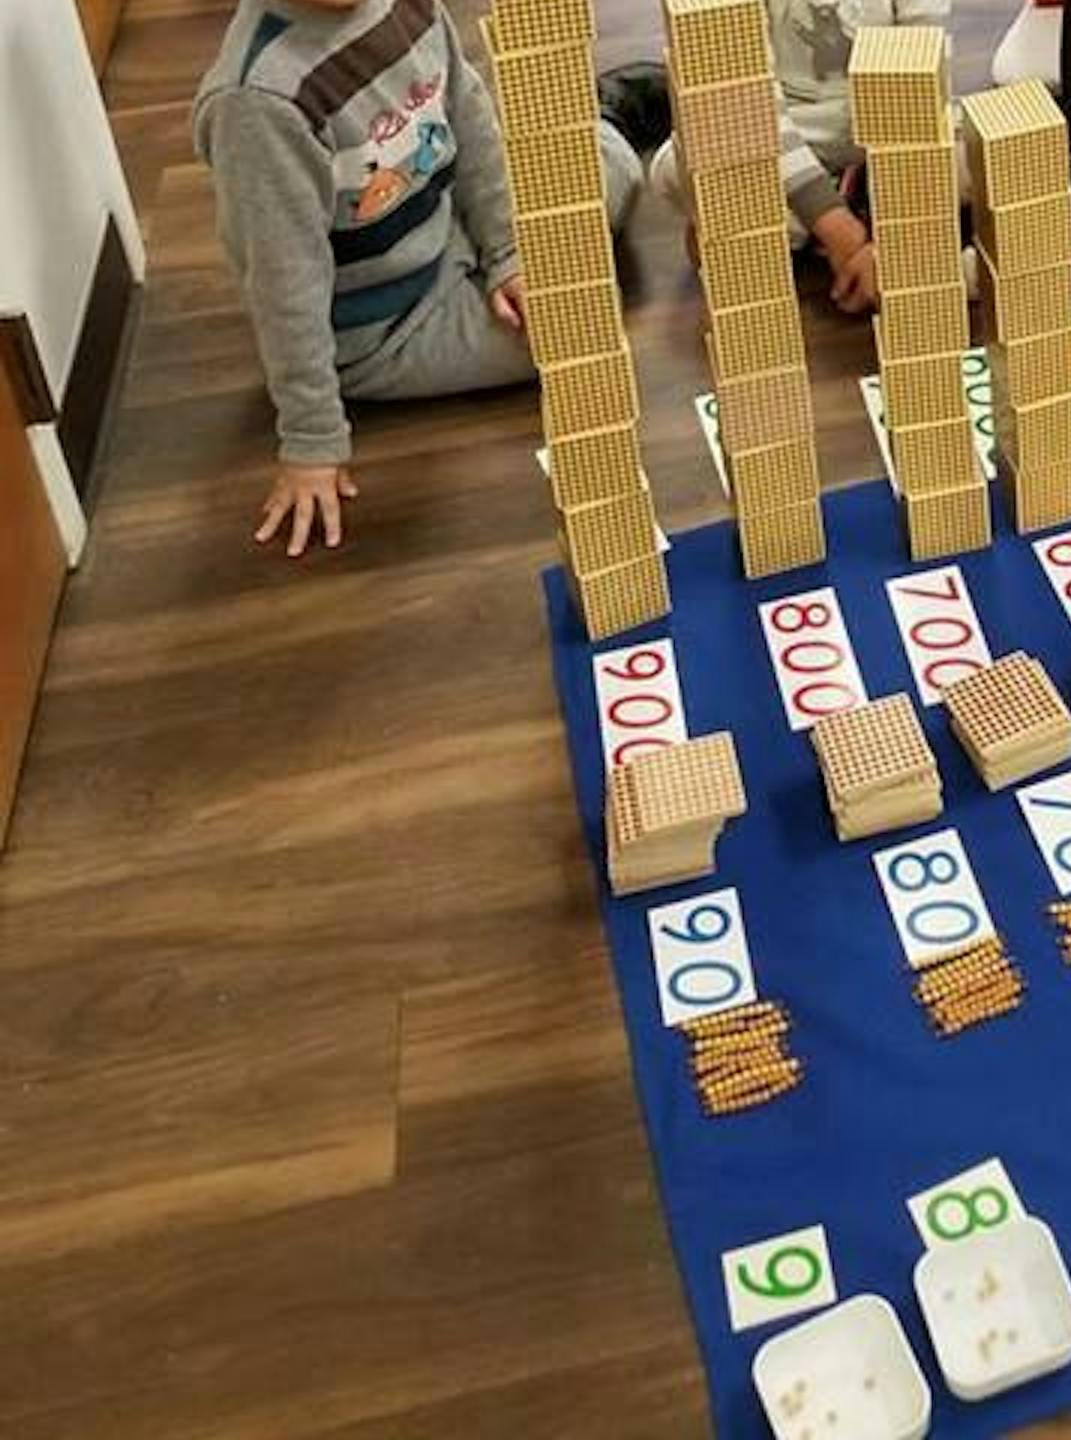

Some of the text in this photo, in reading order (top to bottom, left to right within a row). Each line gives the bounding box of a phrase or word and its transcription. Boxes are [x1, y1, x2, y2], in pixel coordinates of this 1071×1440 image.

[770, 603, 858, 715] 800
[888, 851, 979, 943] 80
[660, 905, 742, 1004] 90
[926, 1187, 1009, 1241] 8
[737, 1247, 822, 1298] 9
